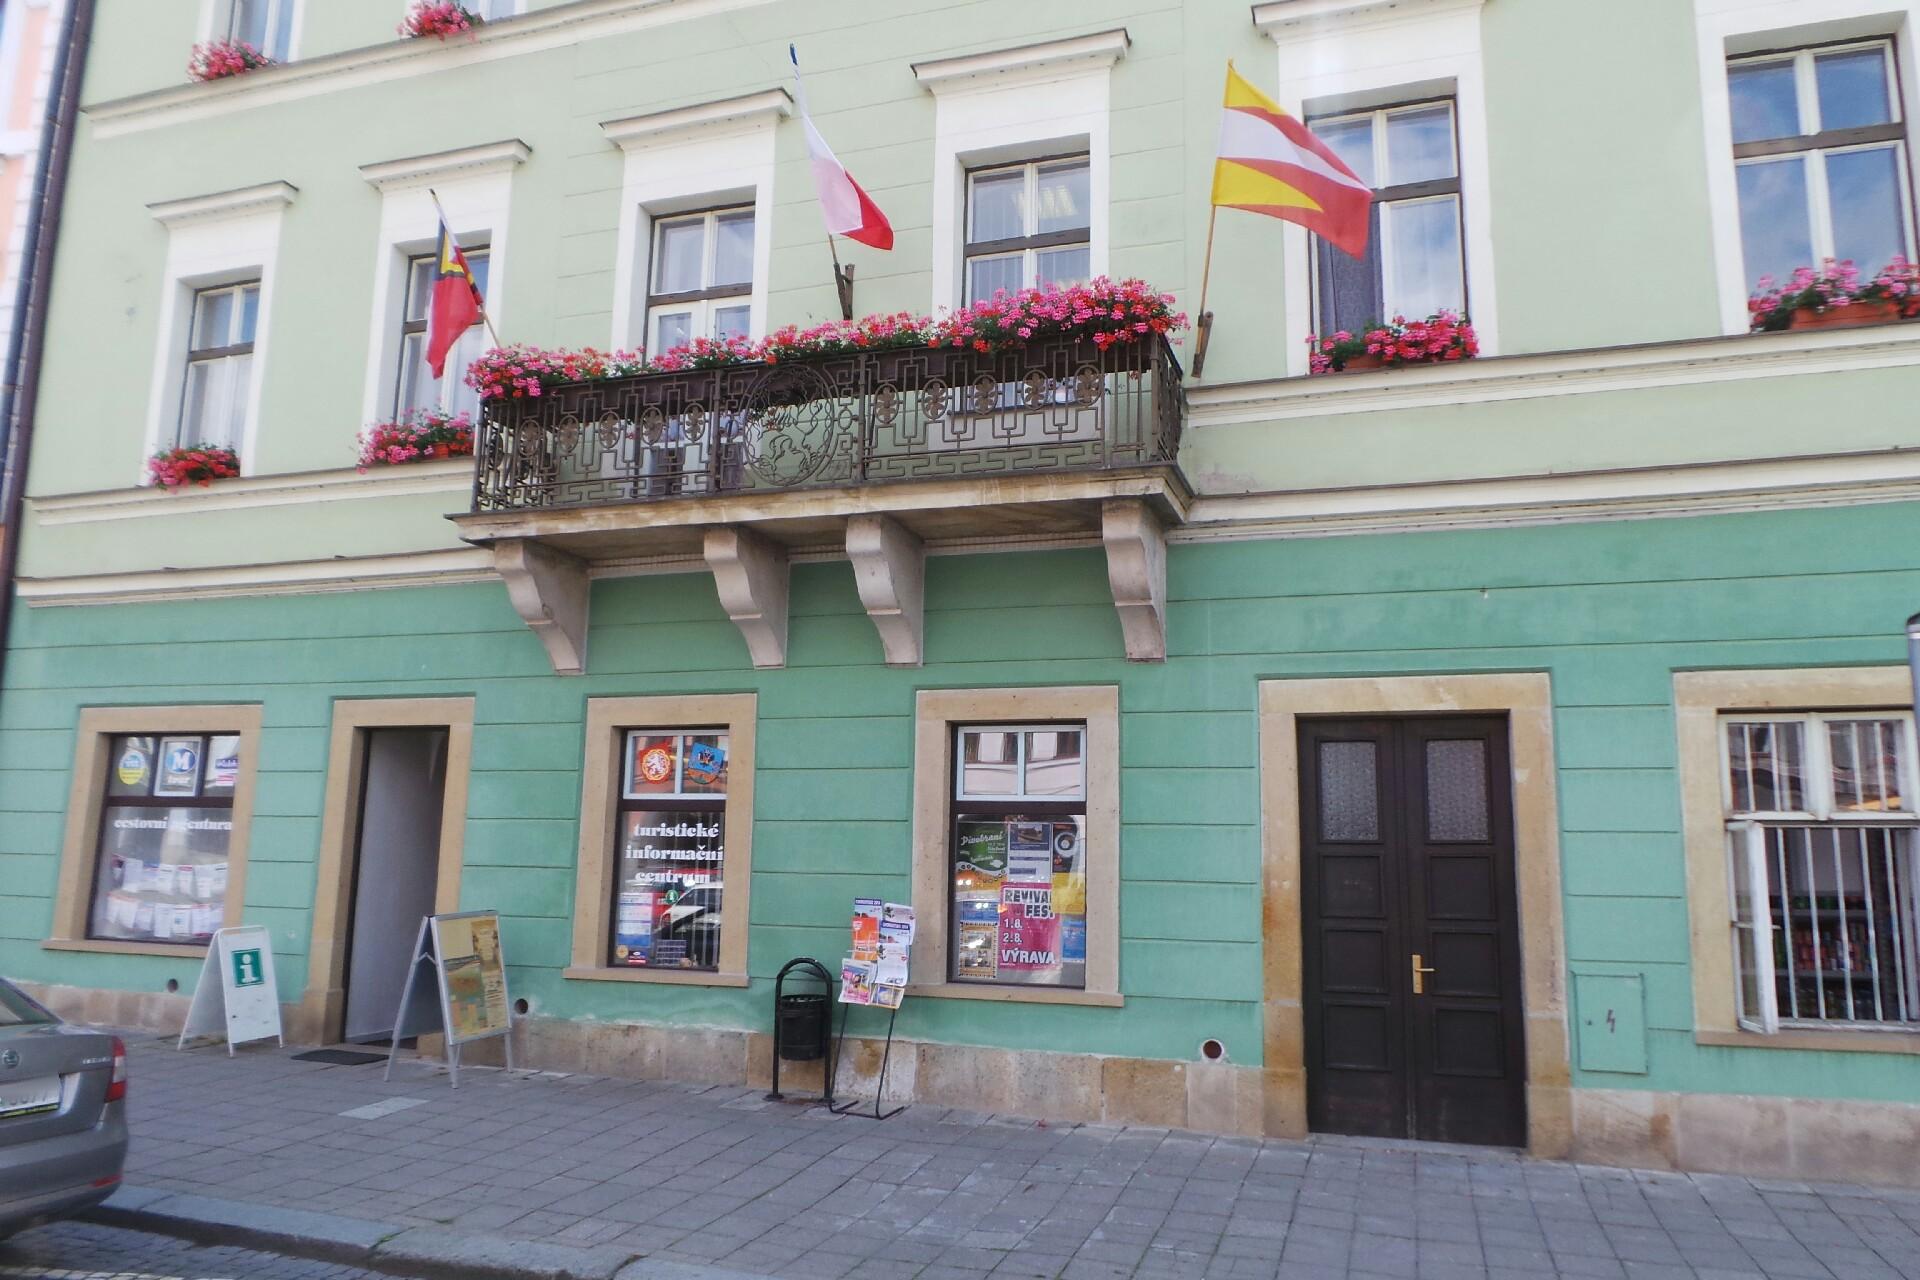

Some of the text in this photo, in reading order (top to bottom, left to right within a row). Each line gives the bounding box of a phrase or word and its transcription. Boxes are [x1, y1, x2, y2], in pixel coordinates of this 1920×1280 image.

[172, 751, 191, 770] M
[170, 818, 233, 831] entura
[633, 822, 720, 838] turistické
[624, 844, 724, 861] informační
[634, 869, 711, 884] centrum
[1001, 947, 1056, 964] VÝRAVA
